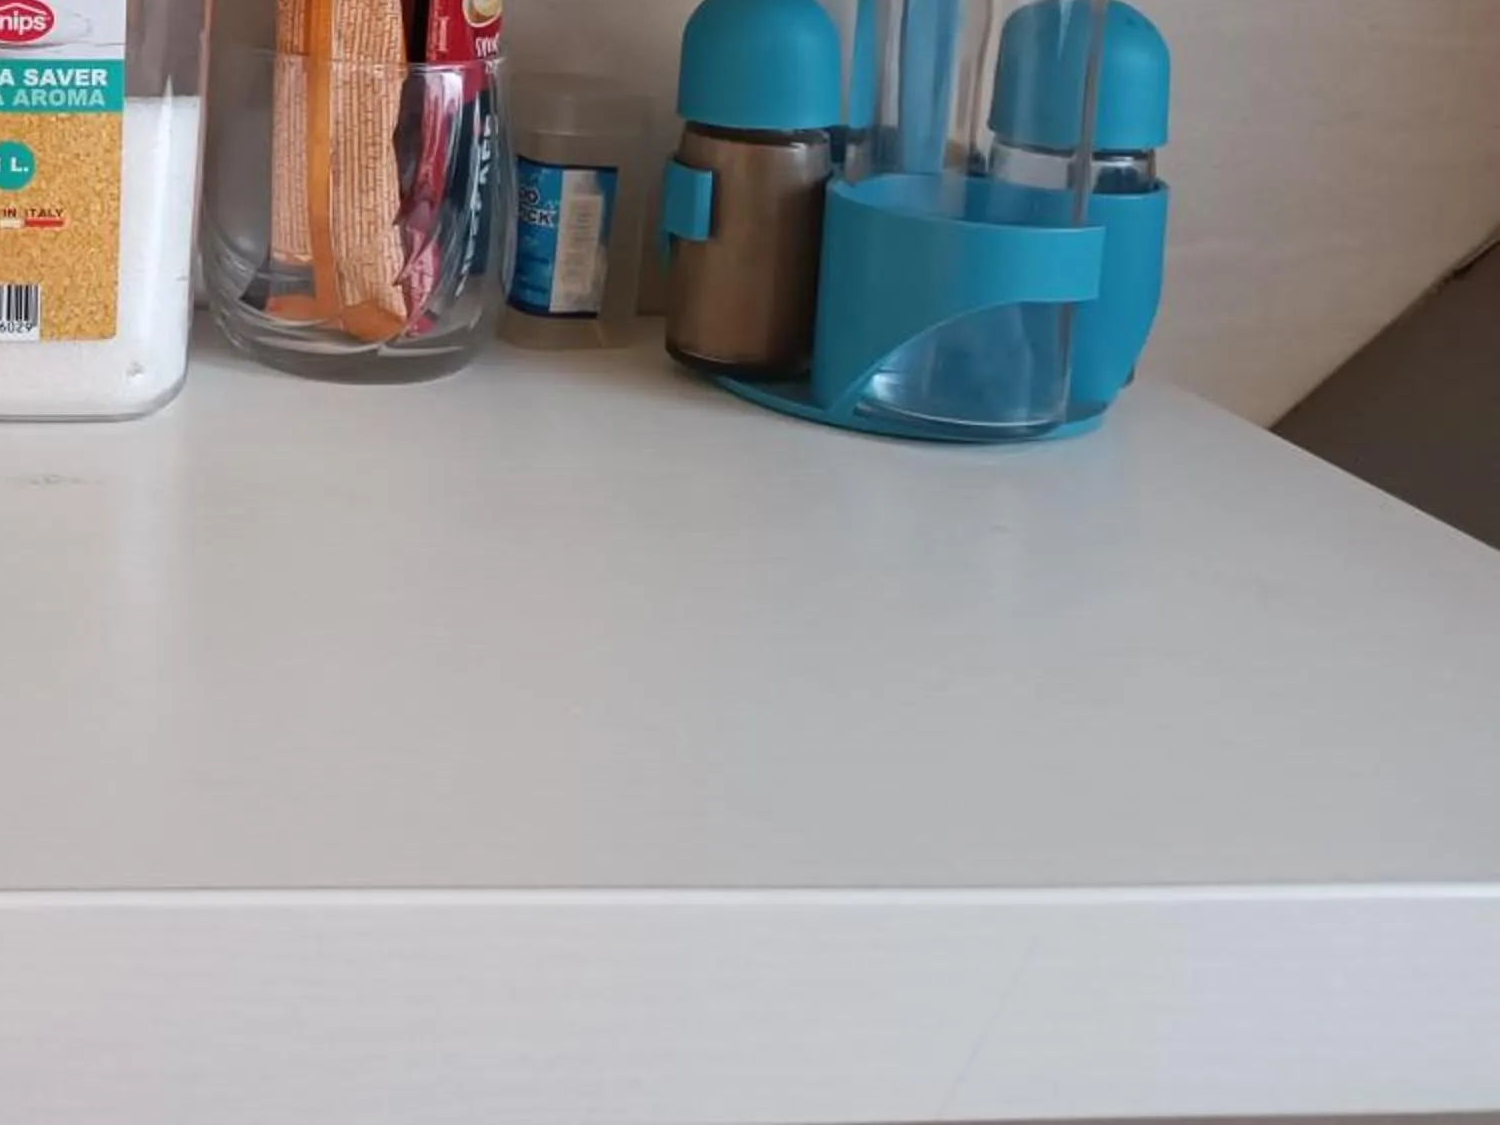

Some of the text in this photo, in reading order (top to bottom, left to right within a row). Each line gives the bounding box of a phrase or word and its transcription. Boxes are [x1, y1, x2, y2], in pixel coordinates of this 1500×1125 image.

[23, 68, 108, 87] SAVER
[12, 88, 106, 107] AROMA
[1, 207, 17, 218] IN
[25, 207, 63, 219] ITALY
